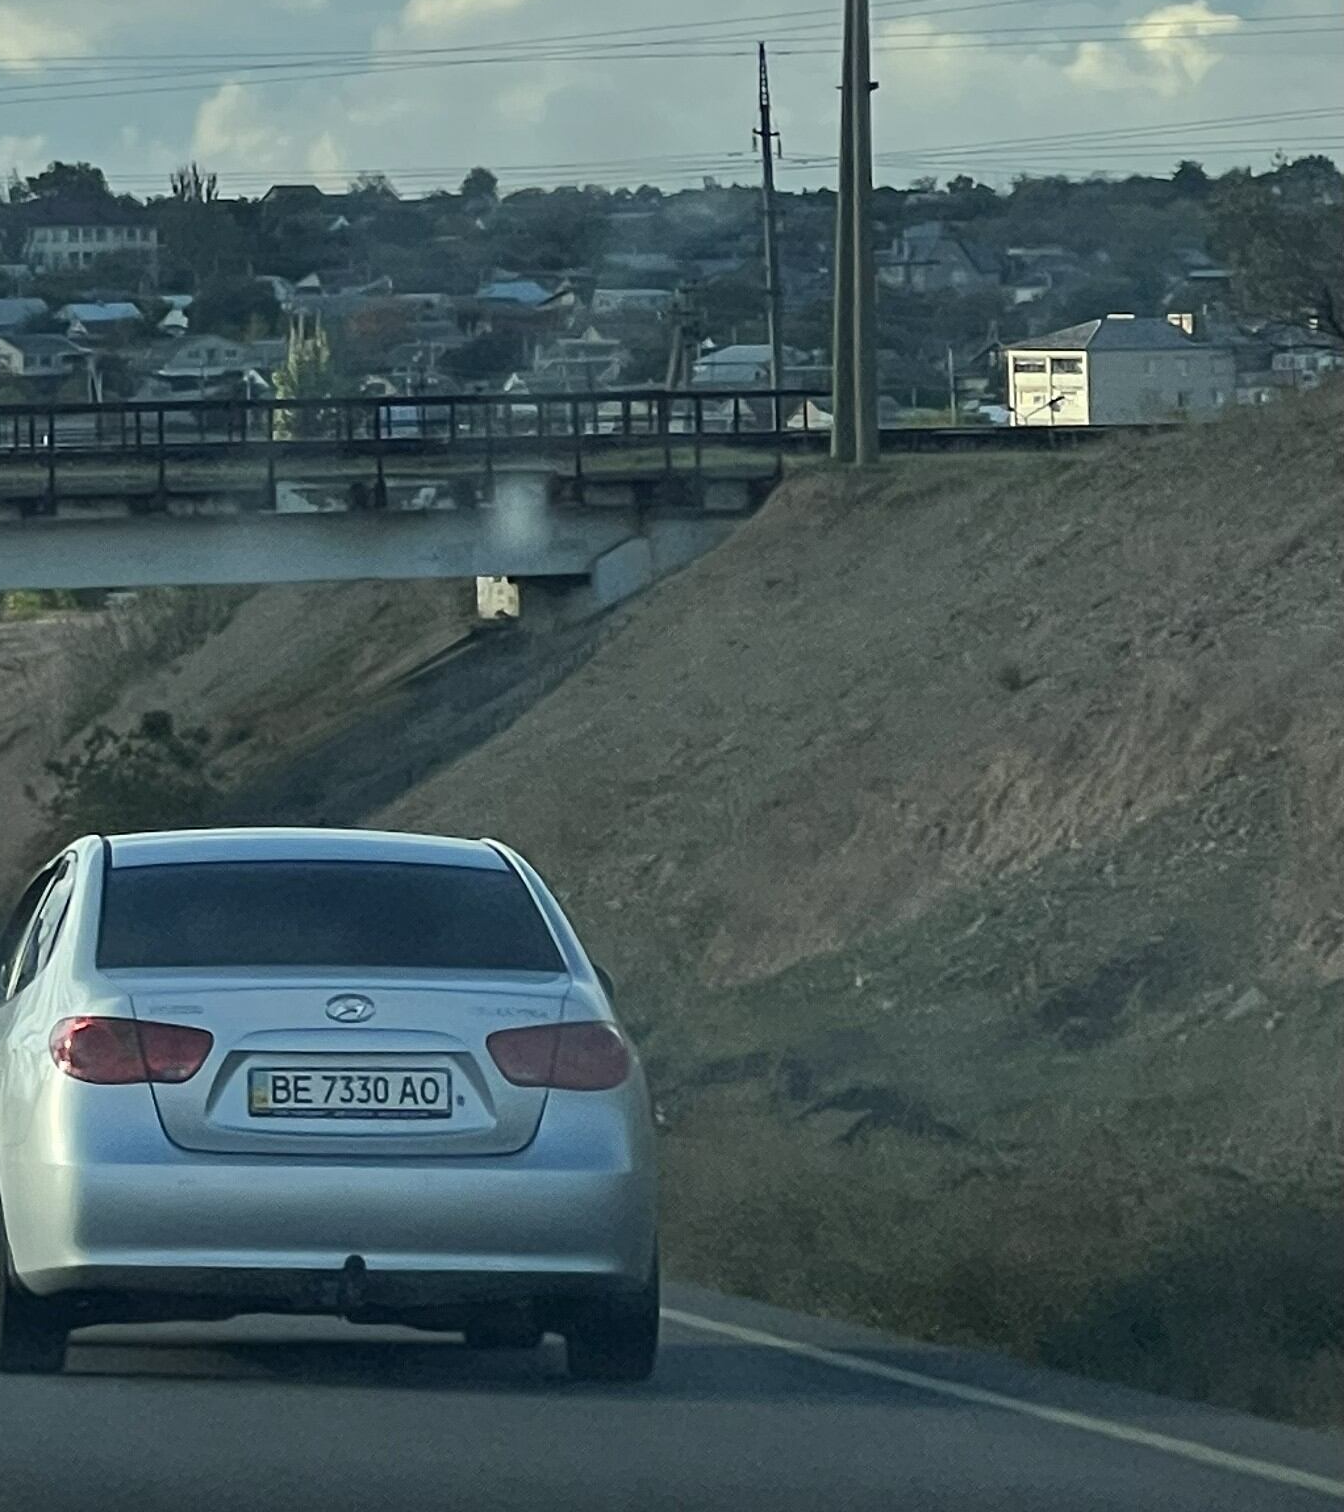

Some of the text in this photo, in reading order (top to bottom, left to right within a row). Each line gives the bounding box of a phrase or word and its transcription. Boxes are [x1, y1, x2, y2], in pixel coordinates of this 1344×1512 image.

[272, 1075, 440, 1104] BE 7330 AO
